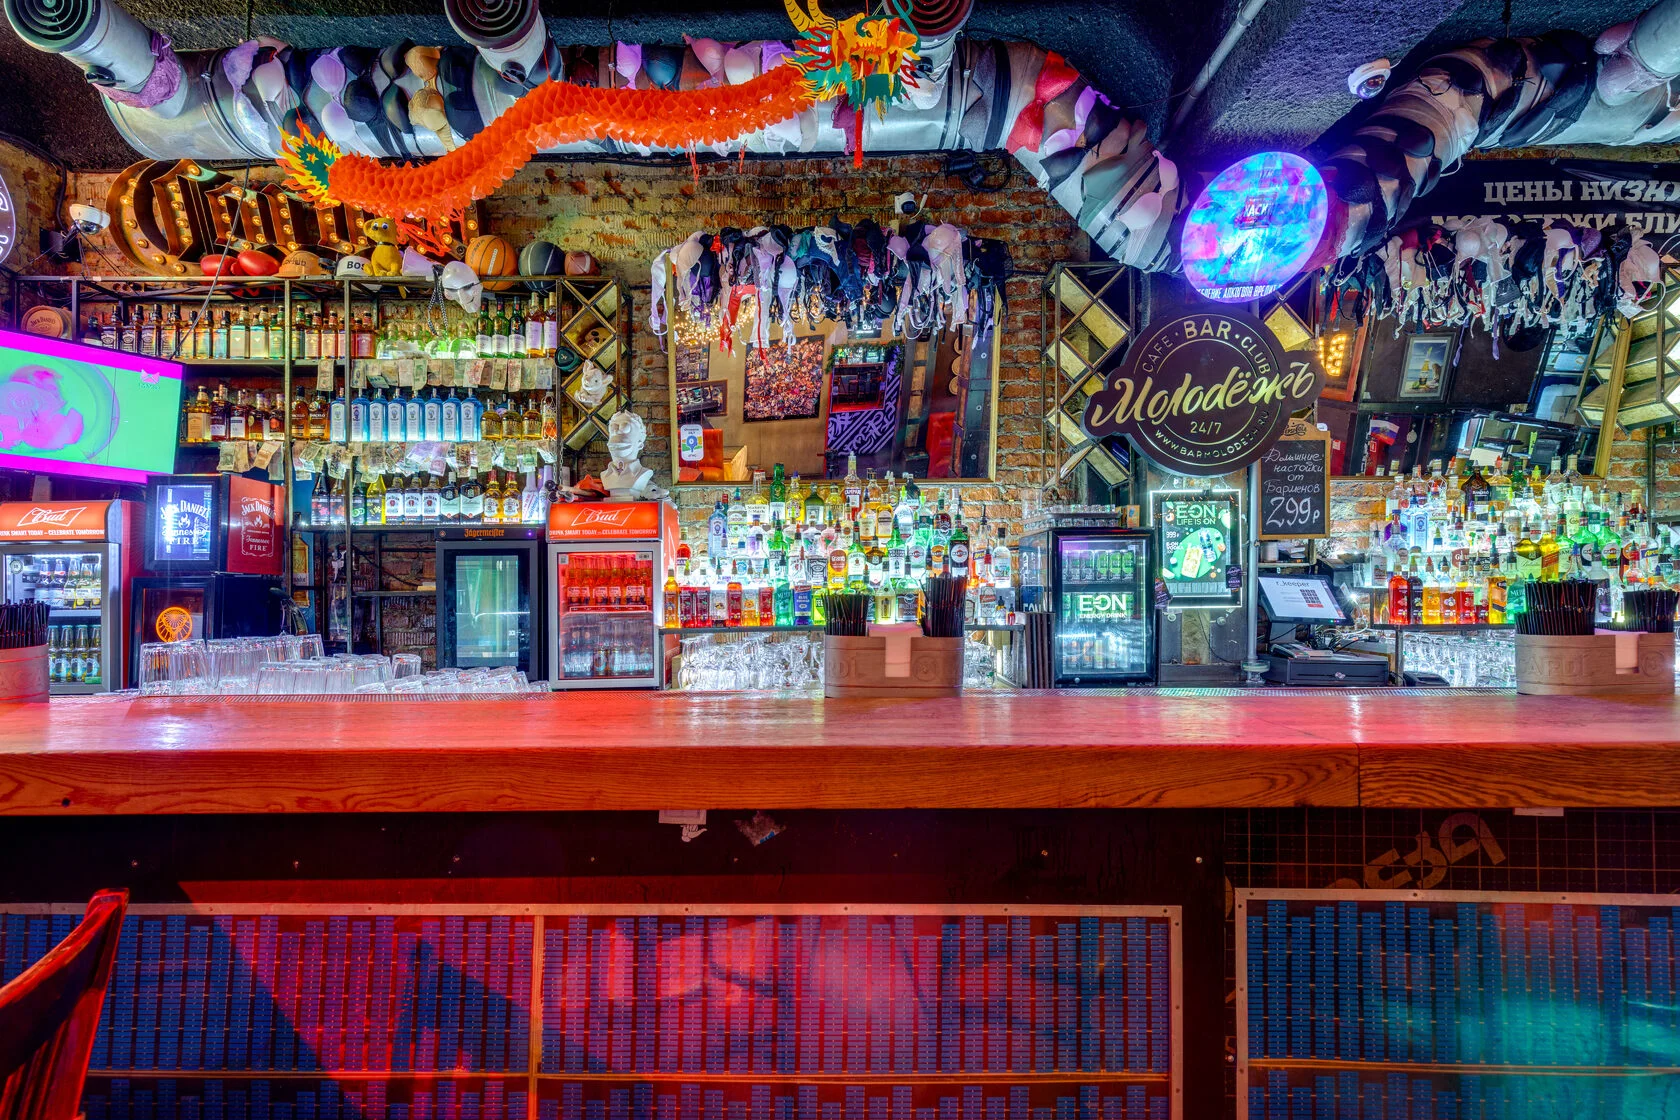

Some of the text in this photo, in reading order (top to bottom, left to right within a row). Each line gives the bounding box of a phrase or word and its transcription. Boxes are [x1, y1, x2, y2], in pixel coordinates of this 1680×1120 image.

[1484, 180, 1573, 205] ЦЕНЫ
[1184, 319, 1232, 340] BAR
[1142, 335, 1173, 374] CAFE
[1240, 336, 1271, 375] CLUB
[1190, 421, 1222, 435] 24/7
[1261, 447, 1323, 462] Домашние
[1274, 461, 1324, 473] настойки
[1287, 474, 1305, 482] от
[1264, 480, 1321, 496] Барменов
[32, 509, 67, 523] Bud
[241, 502, 255, 516] JACK
[584, 510, 619, 522] Bud
[249, 544, 267, 552] FIRE
